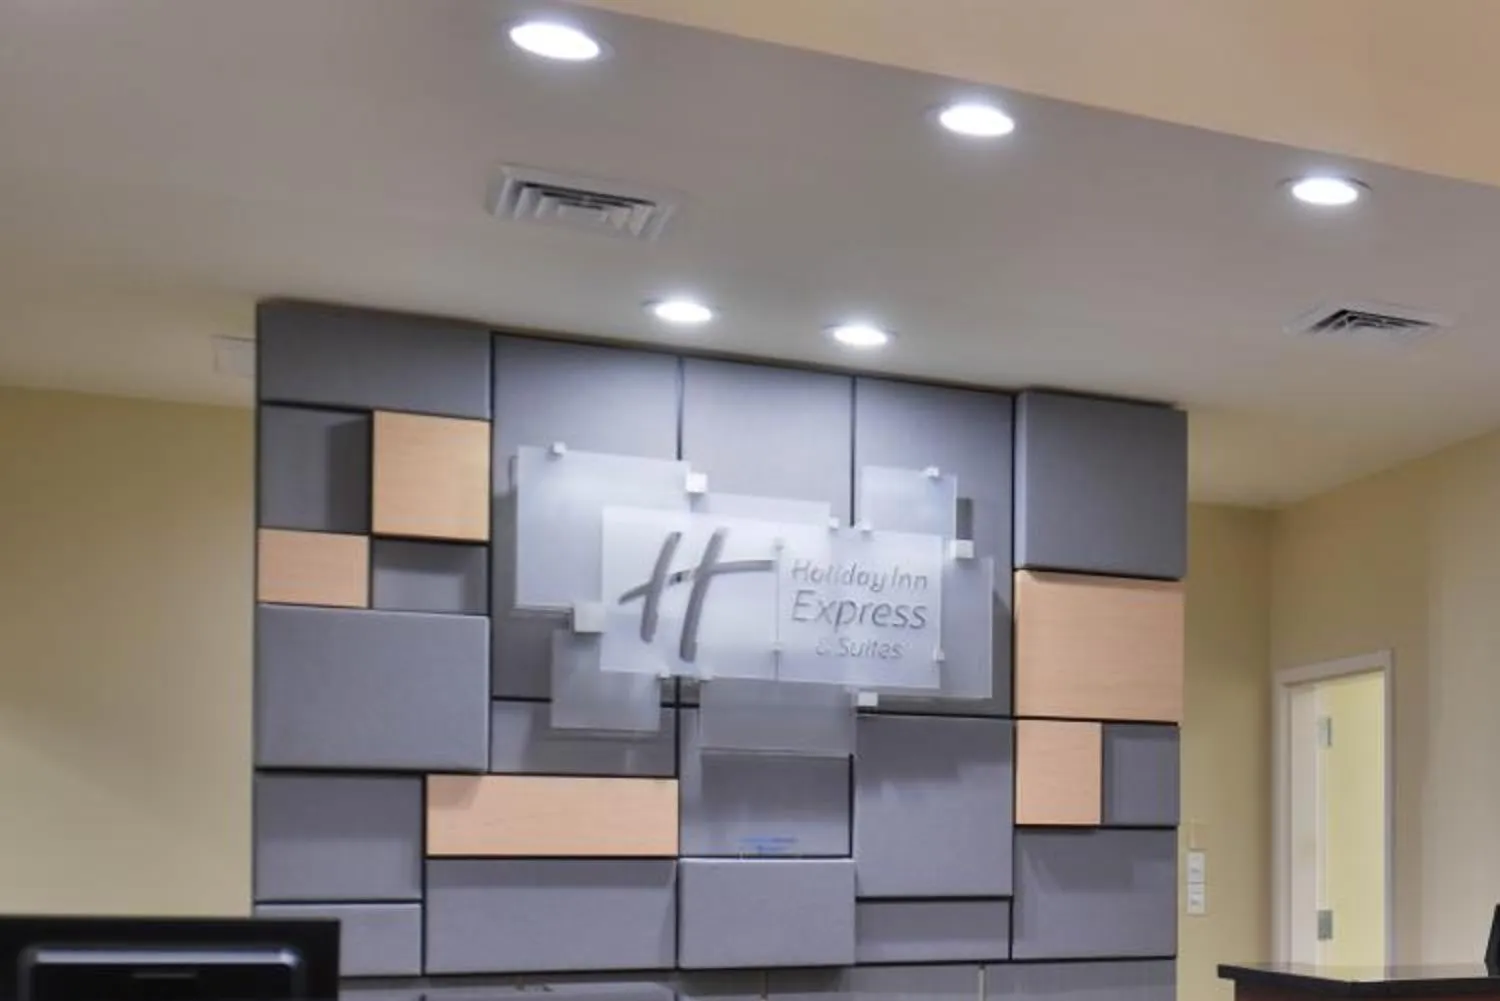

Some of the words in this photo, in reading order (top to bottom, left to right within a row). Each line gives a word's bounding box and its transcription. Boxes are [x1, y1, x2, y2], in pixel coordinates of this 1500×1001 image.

[791, 559, 886, 593] Holiday
[890, 565, 929, 591] Inn
[791, 589, 928, 634] Express
[837, 636, 905, 660] Suites
